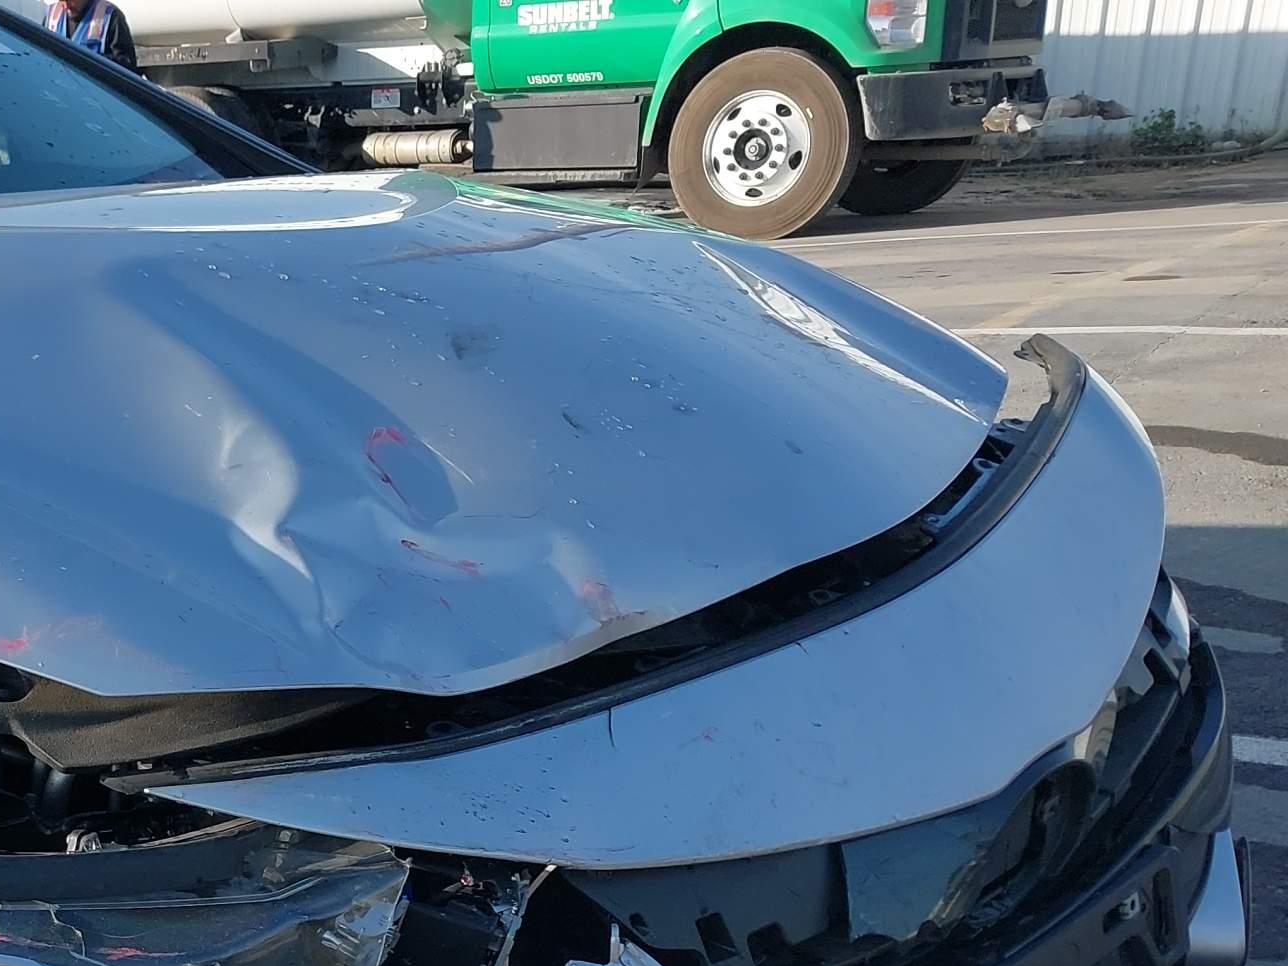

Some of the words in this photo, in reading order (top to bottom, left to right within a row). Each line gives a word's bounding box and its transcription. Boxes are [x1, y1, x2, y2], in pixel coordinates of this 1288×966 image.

[517, 0, 612, 26] SUNBELT
[528, 21, 597, 34] RENTALS
[526, 73, 564, 85] USDOT
